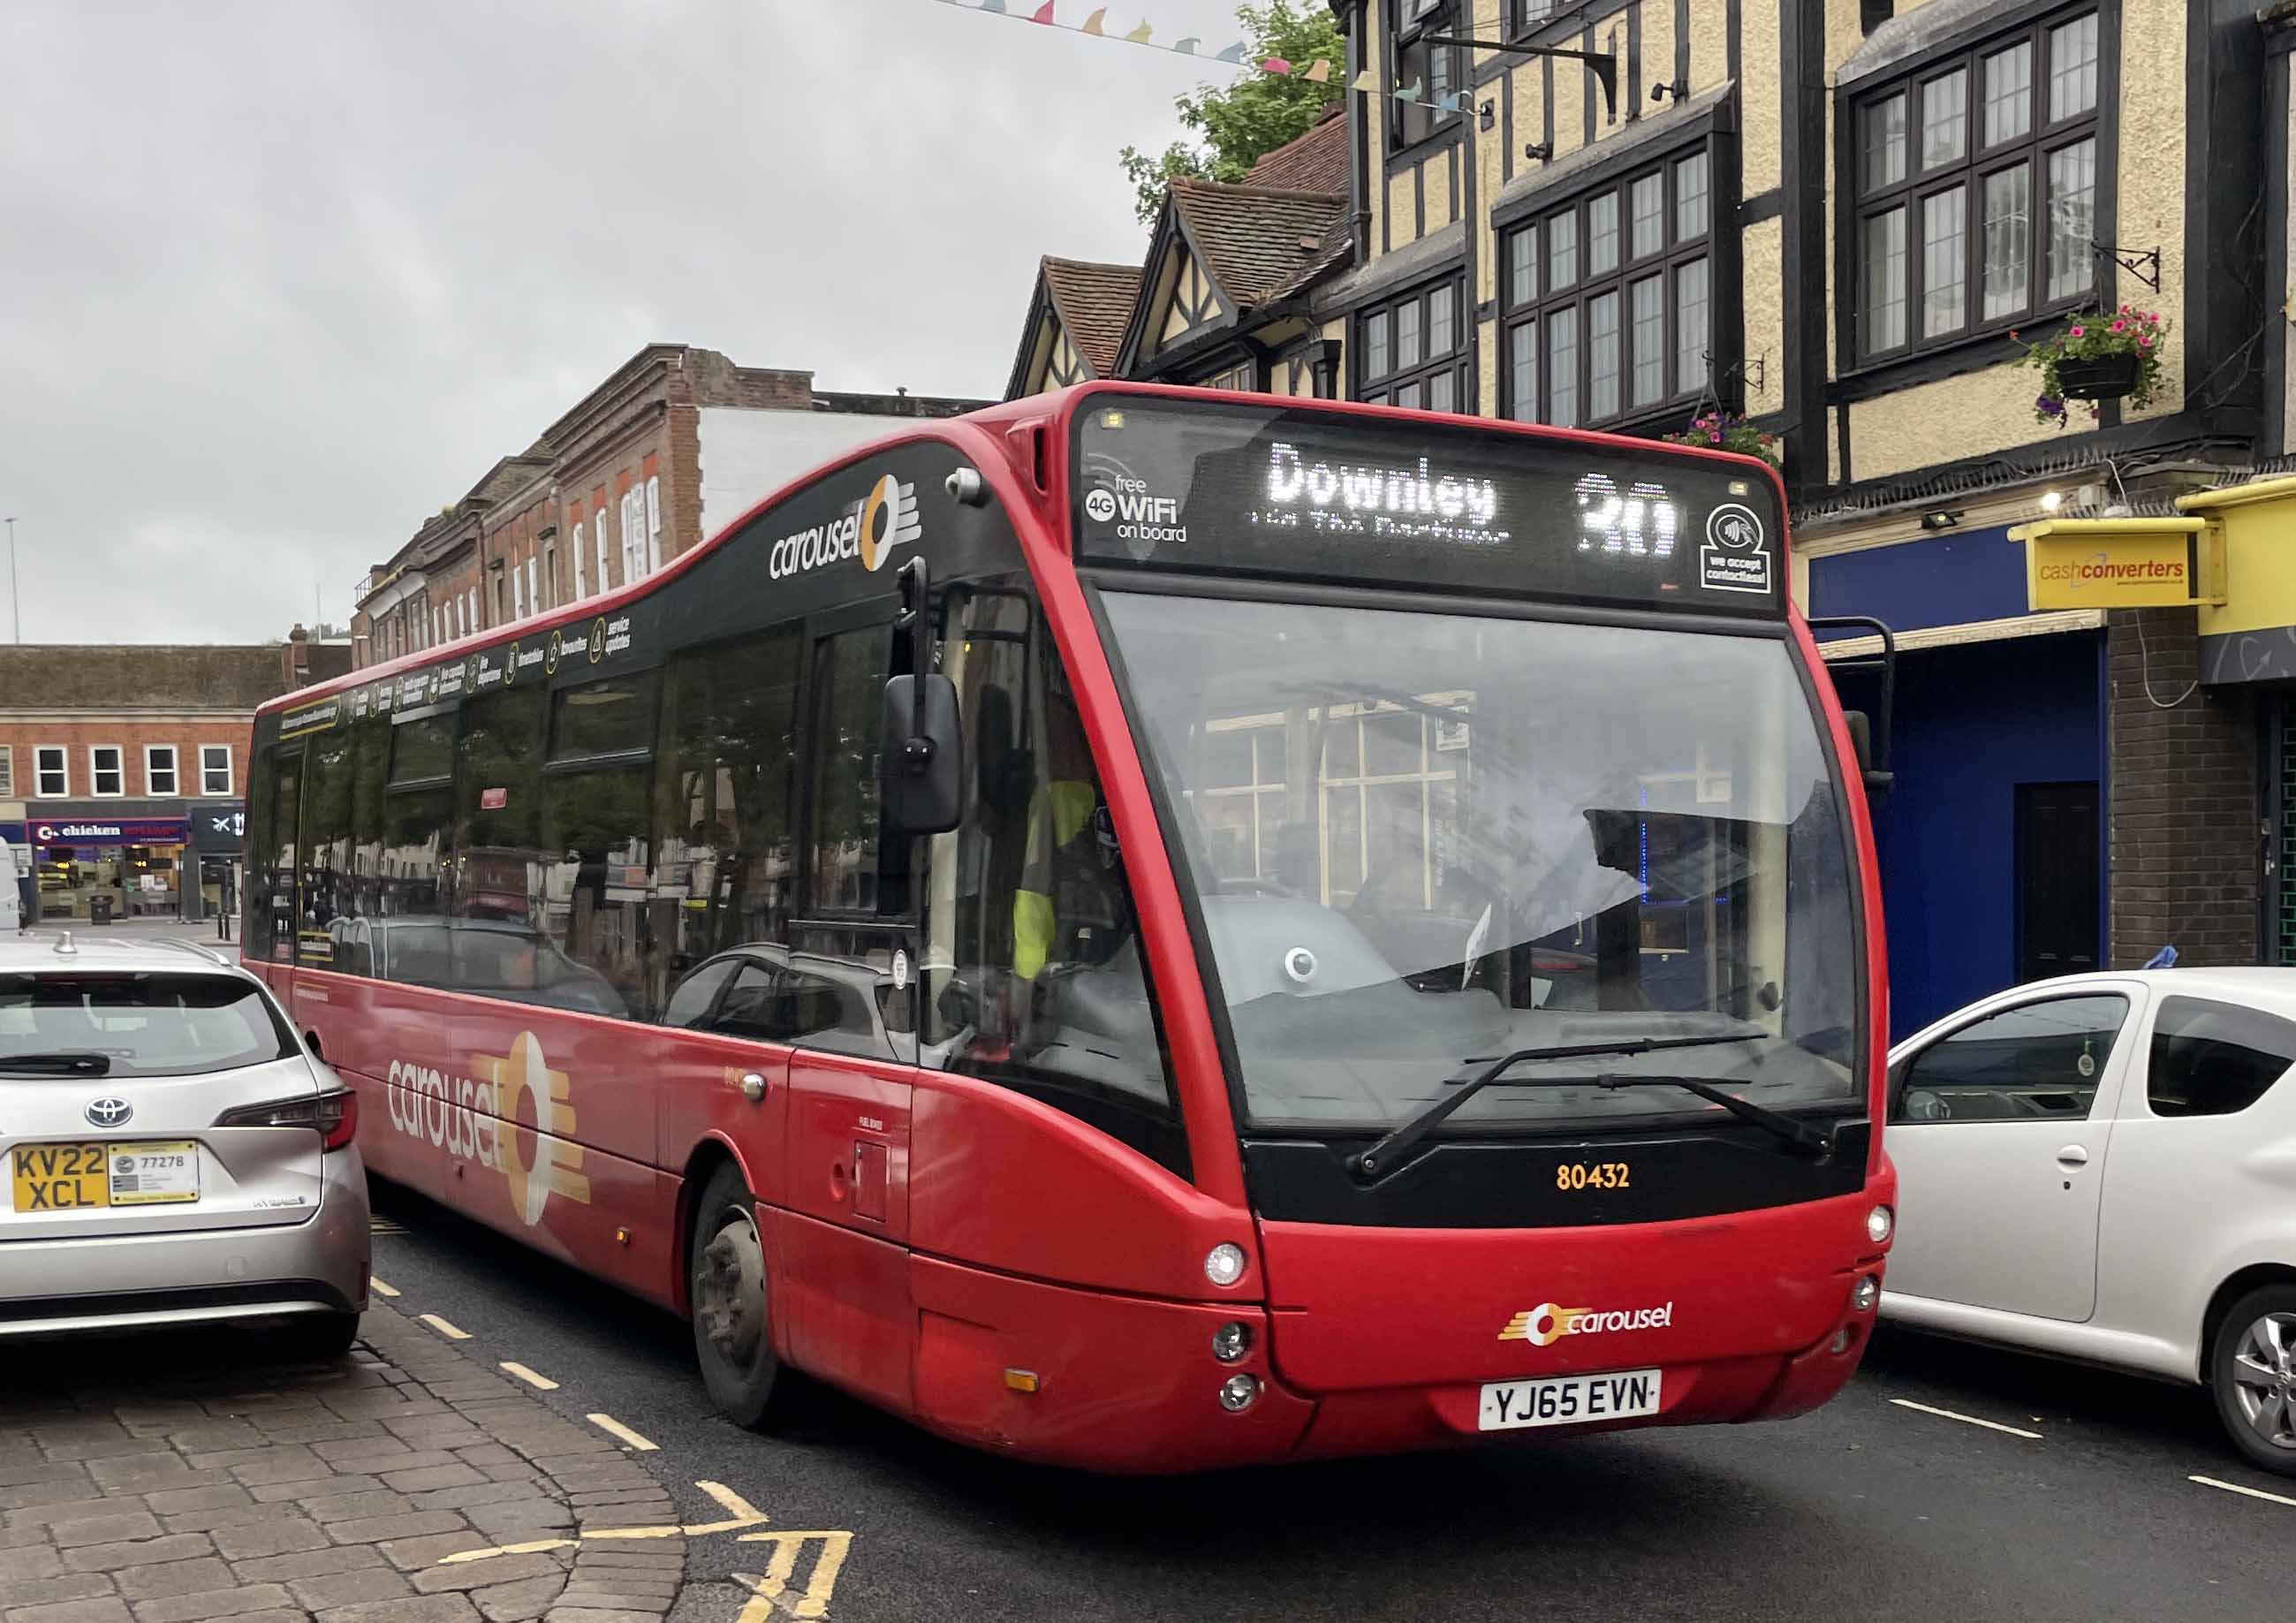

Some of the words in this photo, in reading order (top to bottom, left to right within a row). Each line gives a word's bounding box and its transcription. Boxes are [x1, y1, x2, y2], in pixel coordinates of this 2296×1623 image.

[1115, 474, 1147, 493] free
[1088, 497, 1113, 513] 4G
[1117, 494, 1178, 524] WiFi
[1268, 442, 1495, 525] Downley
[1575, 472, 1675, 557] 30
[769, 499, 864, 580] carousel
[1117, 524, 1138, 539] on
[1140, 523, 1187, 542] board
[1709, 556, 1726, 567] we
[1726, 557, 1762, 573] accept
[62, 824, 120, 836] chicken
[389, 1059, 502, 1170] carousel
[16, 1148, 104, 1178] KV22
[140, 1156, 185, 1169] 77278
[1557, 1163, 1630, 1190] 80432
[29, 1179, 95, 1210] XCL
[1567, 1301, 1673, 1334] carousel
[1496, 1383, 1580, 1422] YJ65
[1588, 1376, 1648, 1414] EVN
